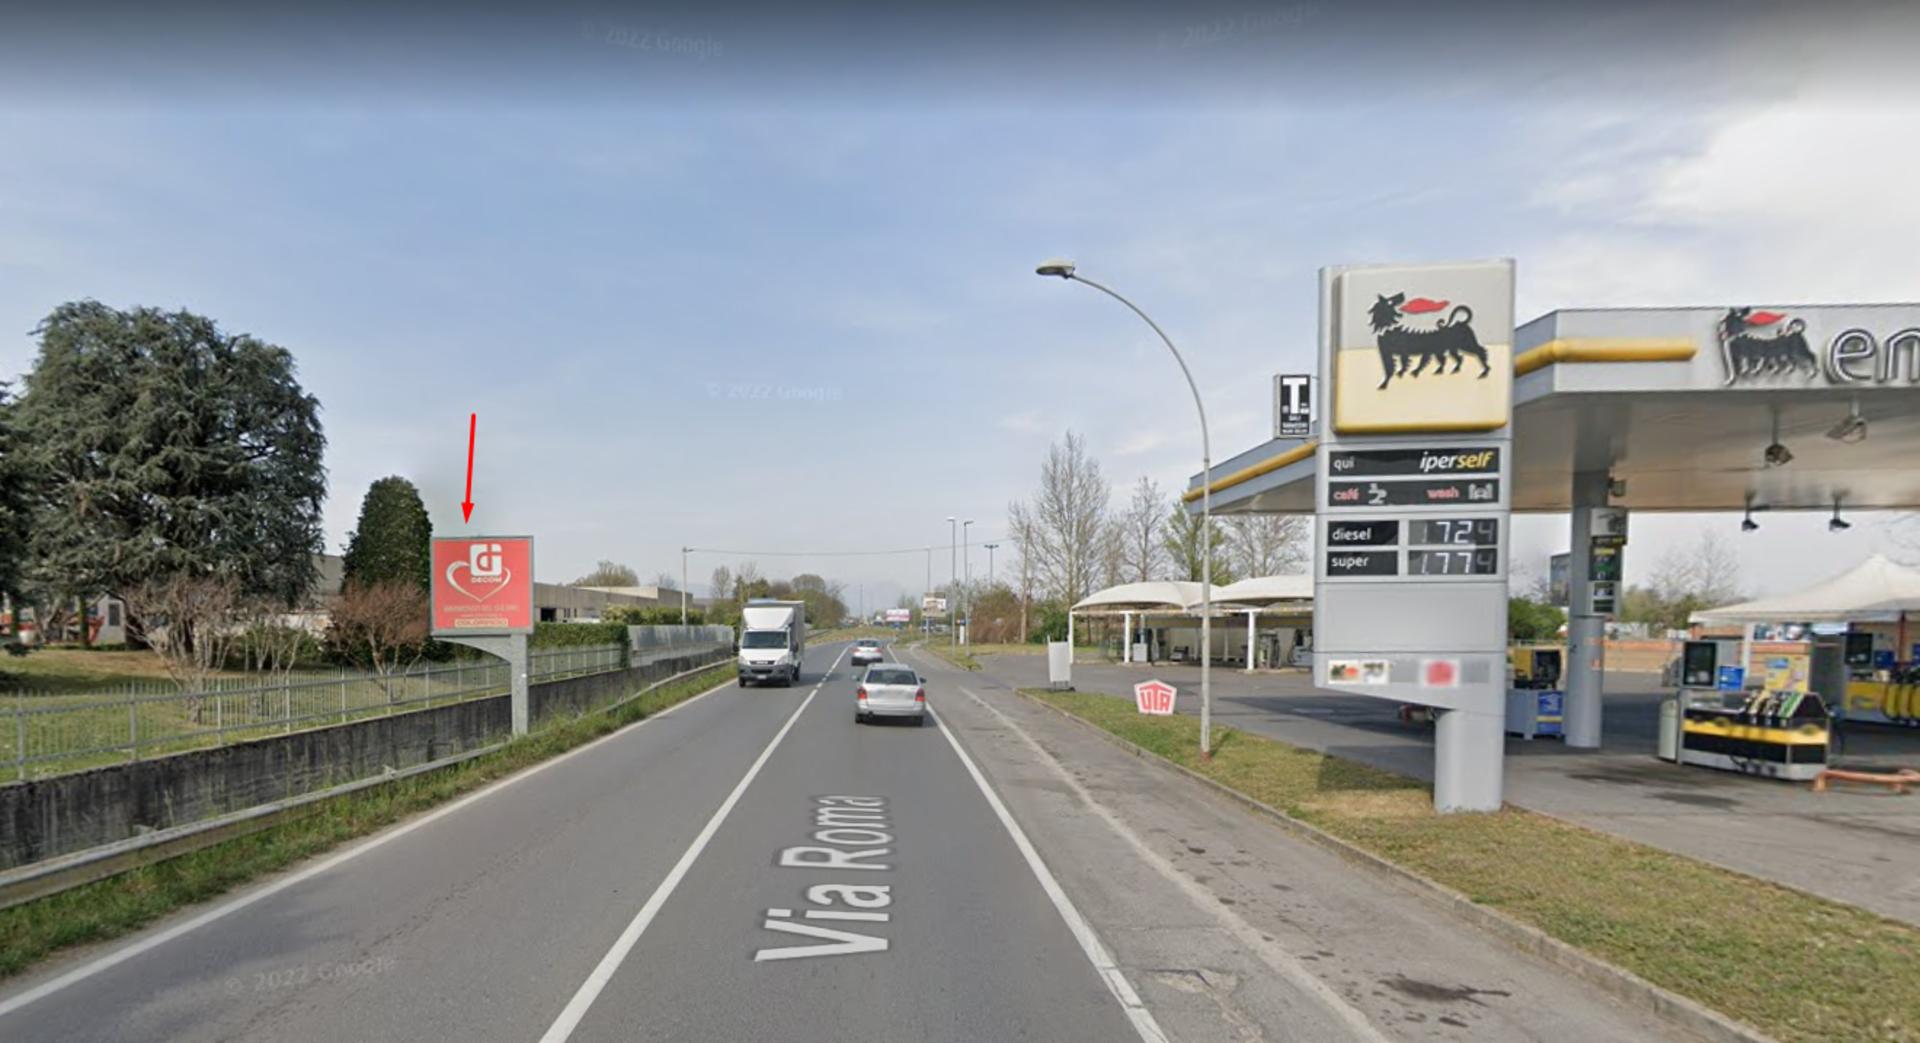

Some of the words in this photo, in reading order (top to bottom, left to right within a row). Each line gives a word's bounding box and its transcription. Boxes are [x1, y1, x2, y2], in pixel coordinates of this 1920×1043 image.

[1282, 378, 1308, 413] T
[1333, 456, 1355, 472] qui
[1419, 450, 1493, 473] iperself
[1427, 486, 1460, 500] wash
[1332, 527, 1372, 541] diesel
[1331, 556, 1370, 569] super
[1139, 683, 1173, 712] UTA
